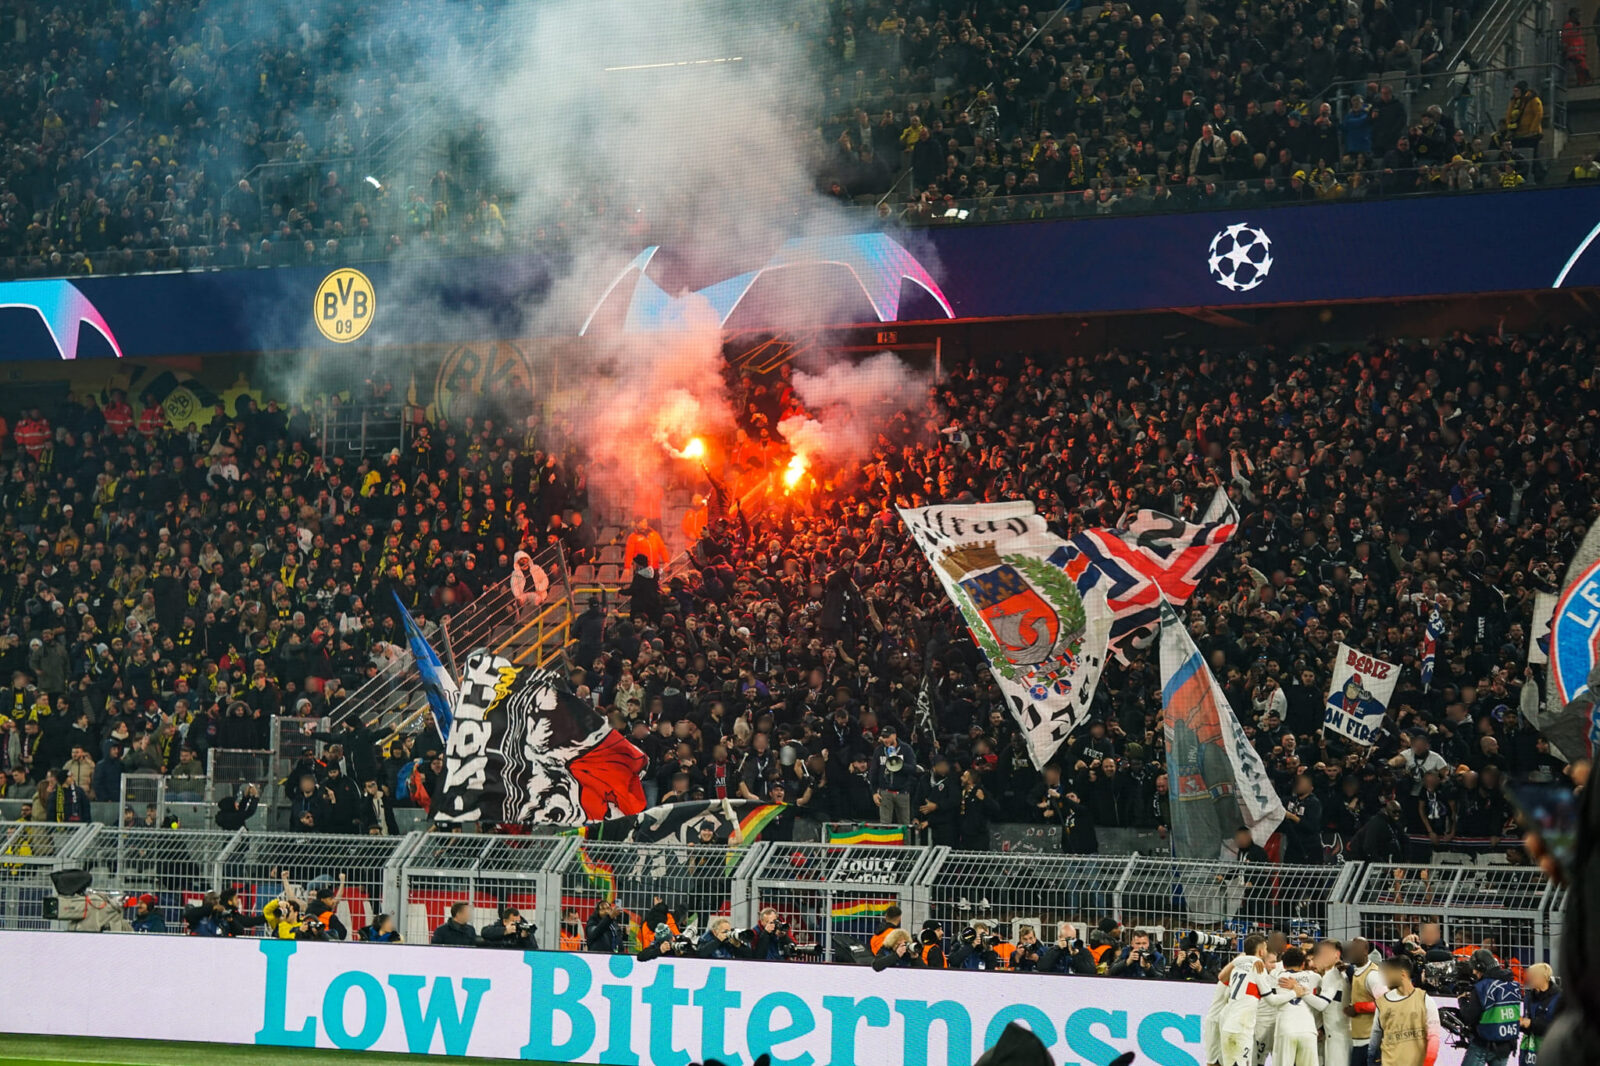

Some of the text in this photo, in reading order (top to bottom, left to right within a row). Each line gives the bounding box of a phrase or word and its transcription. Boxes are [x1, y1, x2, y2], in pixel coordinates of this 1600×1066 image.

[324, 277, 368, 320] BVB
[336, 319, 352, 334] 09
[1346, 649, 1391, 680] BERIZ
[1324, 707, 1344, 728] ON
[255, 940, 1201, 1066] Low Bitterness
[1500, 1008, 1515, 1020] HB
[1499, 1024, 1517, 1037] 045
